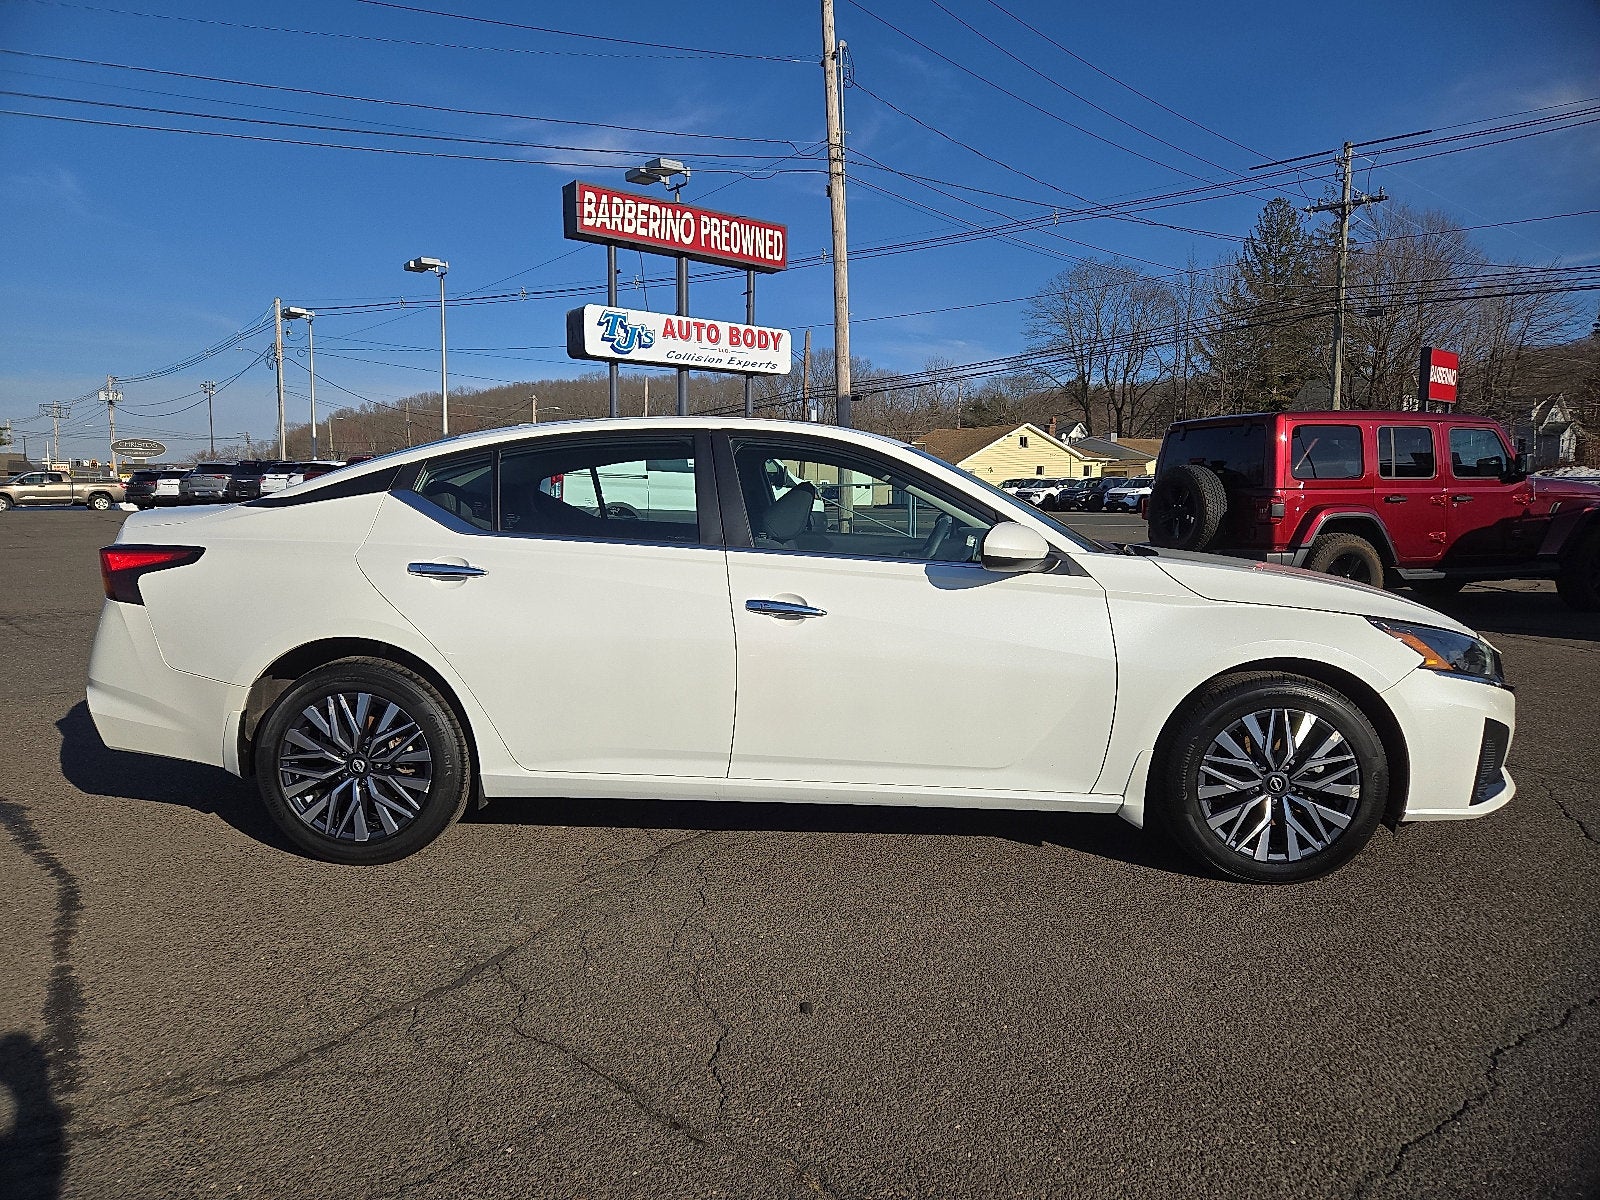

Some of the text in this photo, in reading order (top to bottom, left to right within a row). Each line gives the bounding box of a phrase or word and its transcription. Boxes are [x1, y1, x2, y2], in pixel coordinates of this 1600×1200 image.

[583, 190, 784, 262] BARBERINO PREOWNED
[662, 318, 783, 352] AUTO BODY
[666, 350, 778, 370] Collision Experts
